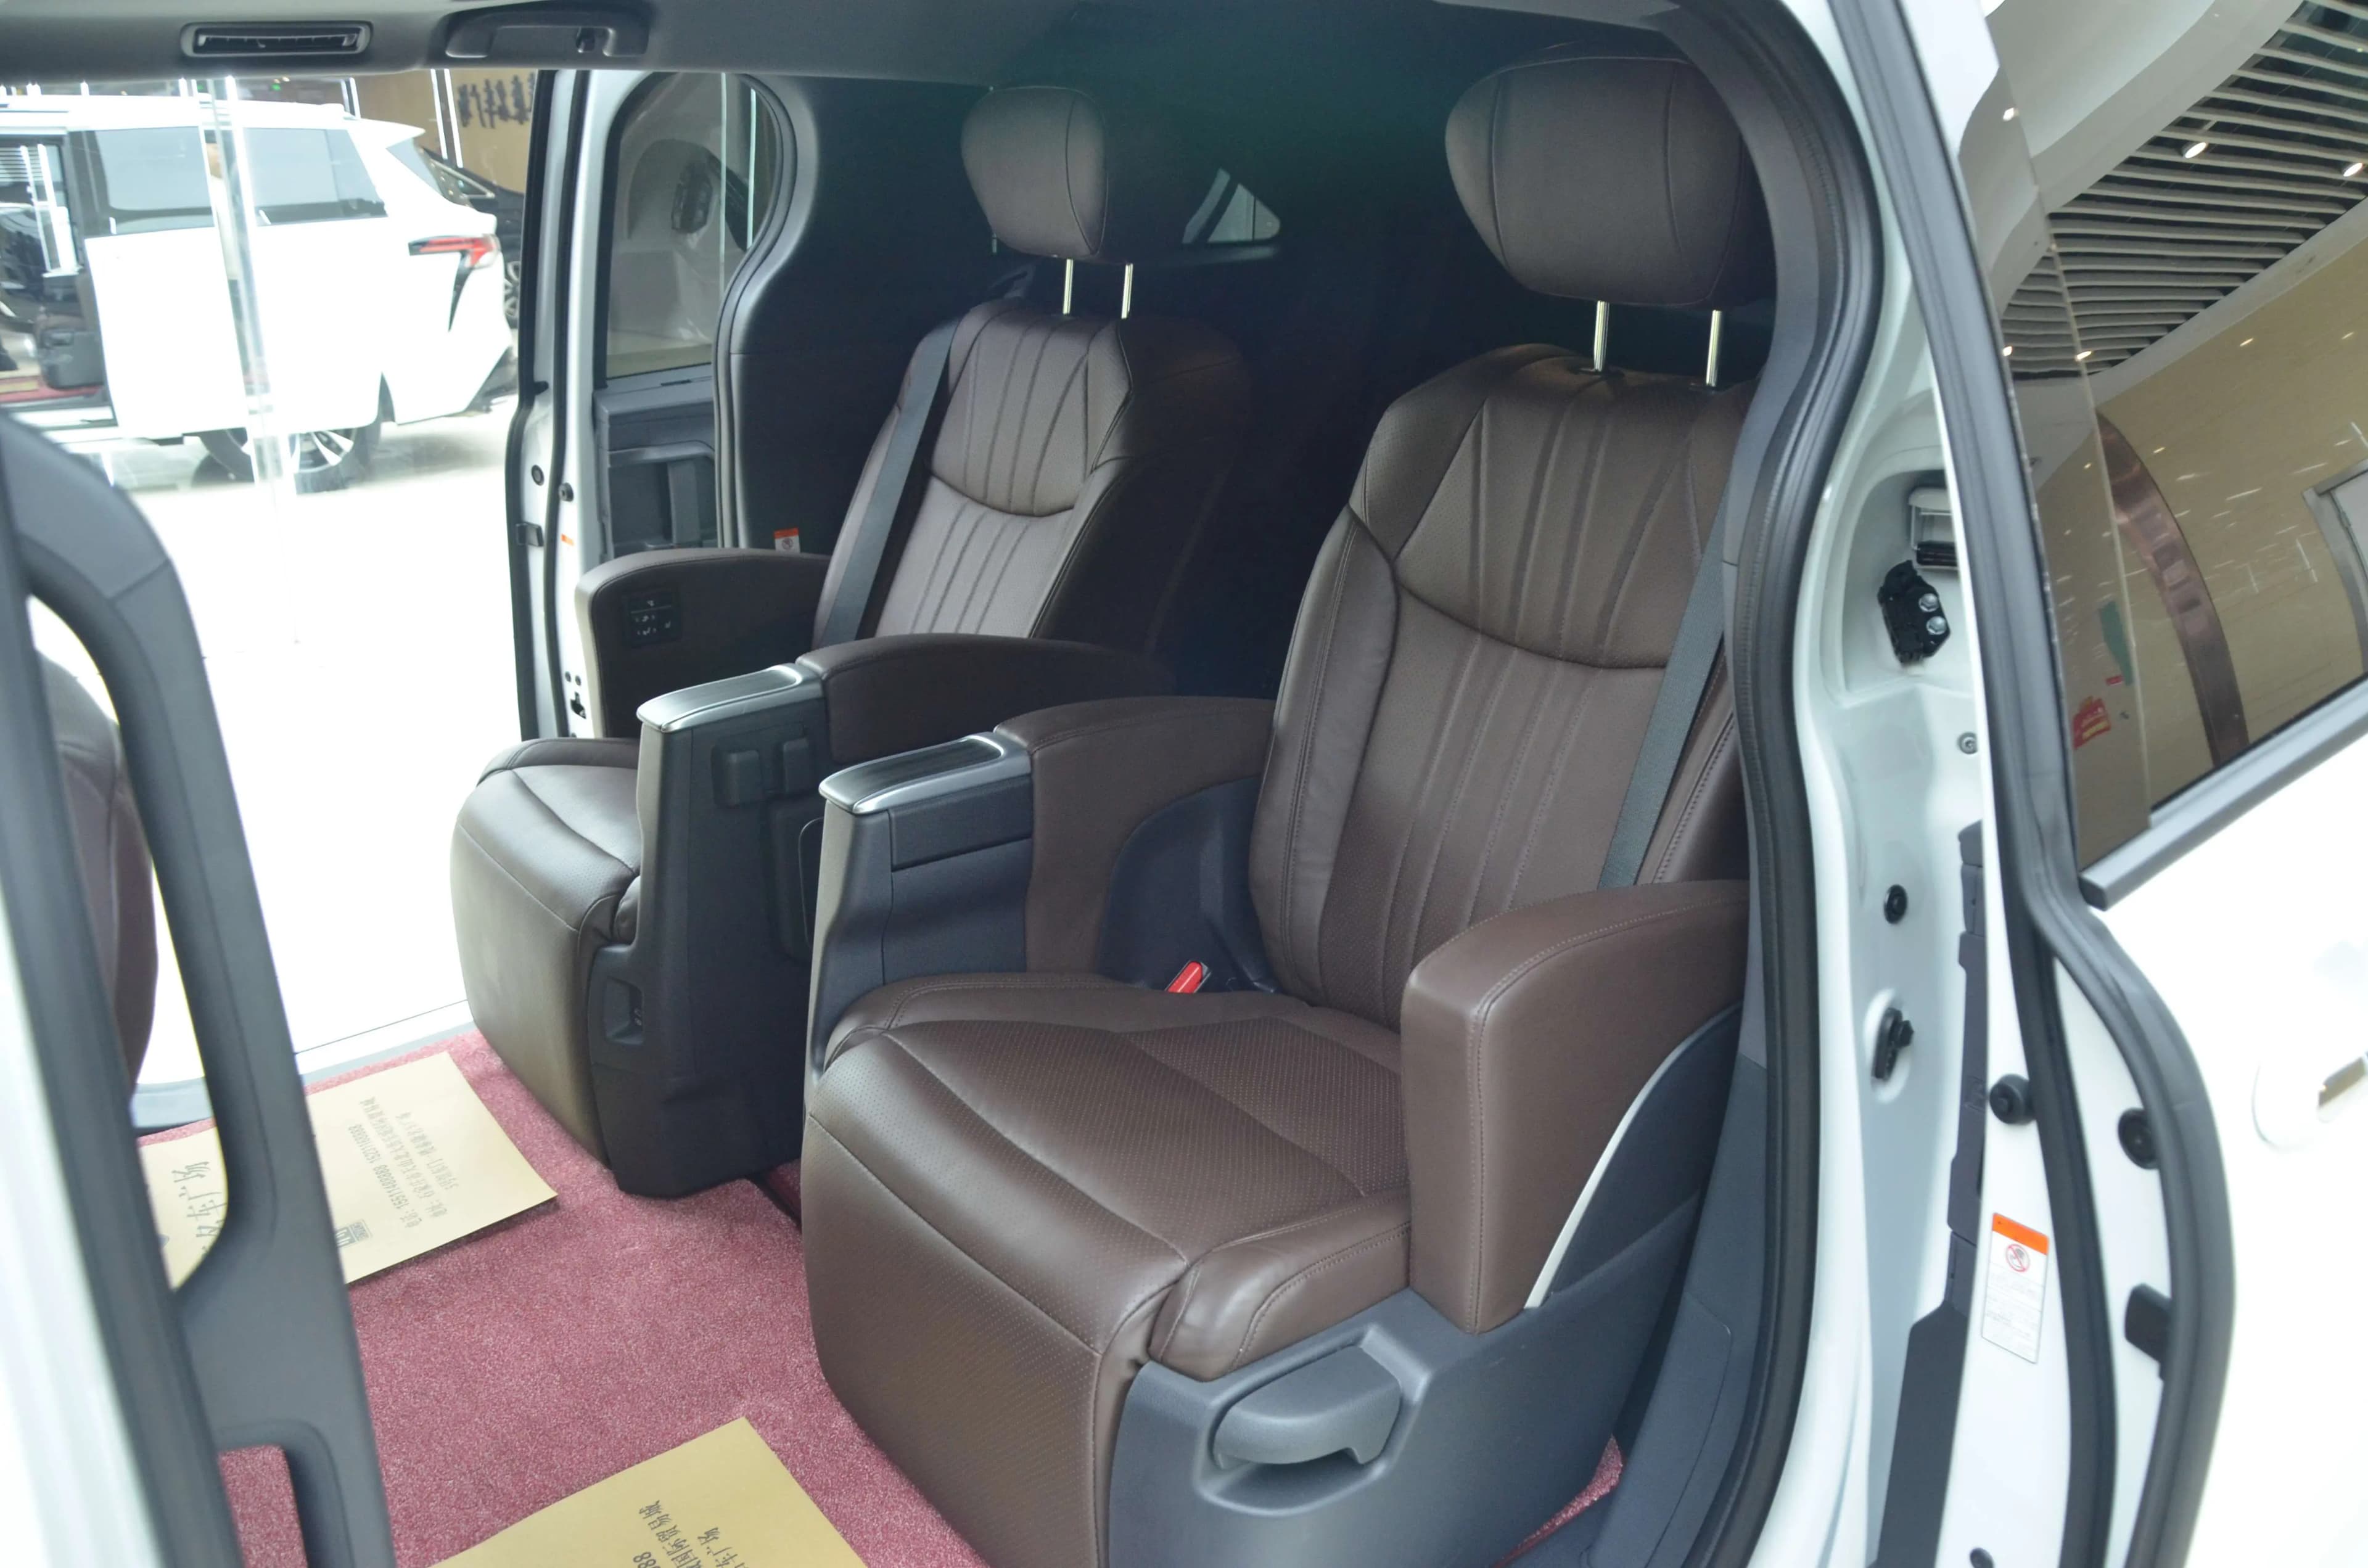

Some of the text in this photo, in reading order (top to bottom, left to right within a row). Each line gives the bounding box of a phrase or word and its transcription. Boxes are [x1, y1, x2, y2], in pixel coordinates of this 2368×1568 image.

[639, 1500, 702, 1568] 国际贸易城
[697, 1527, 749, 1568] 车广场
